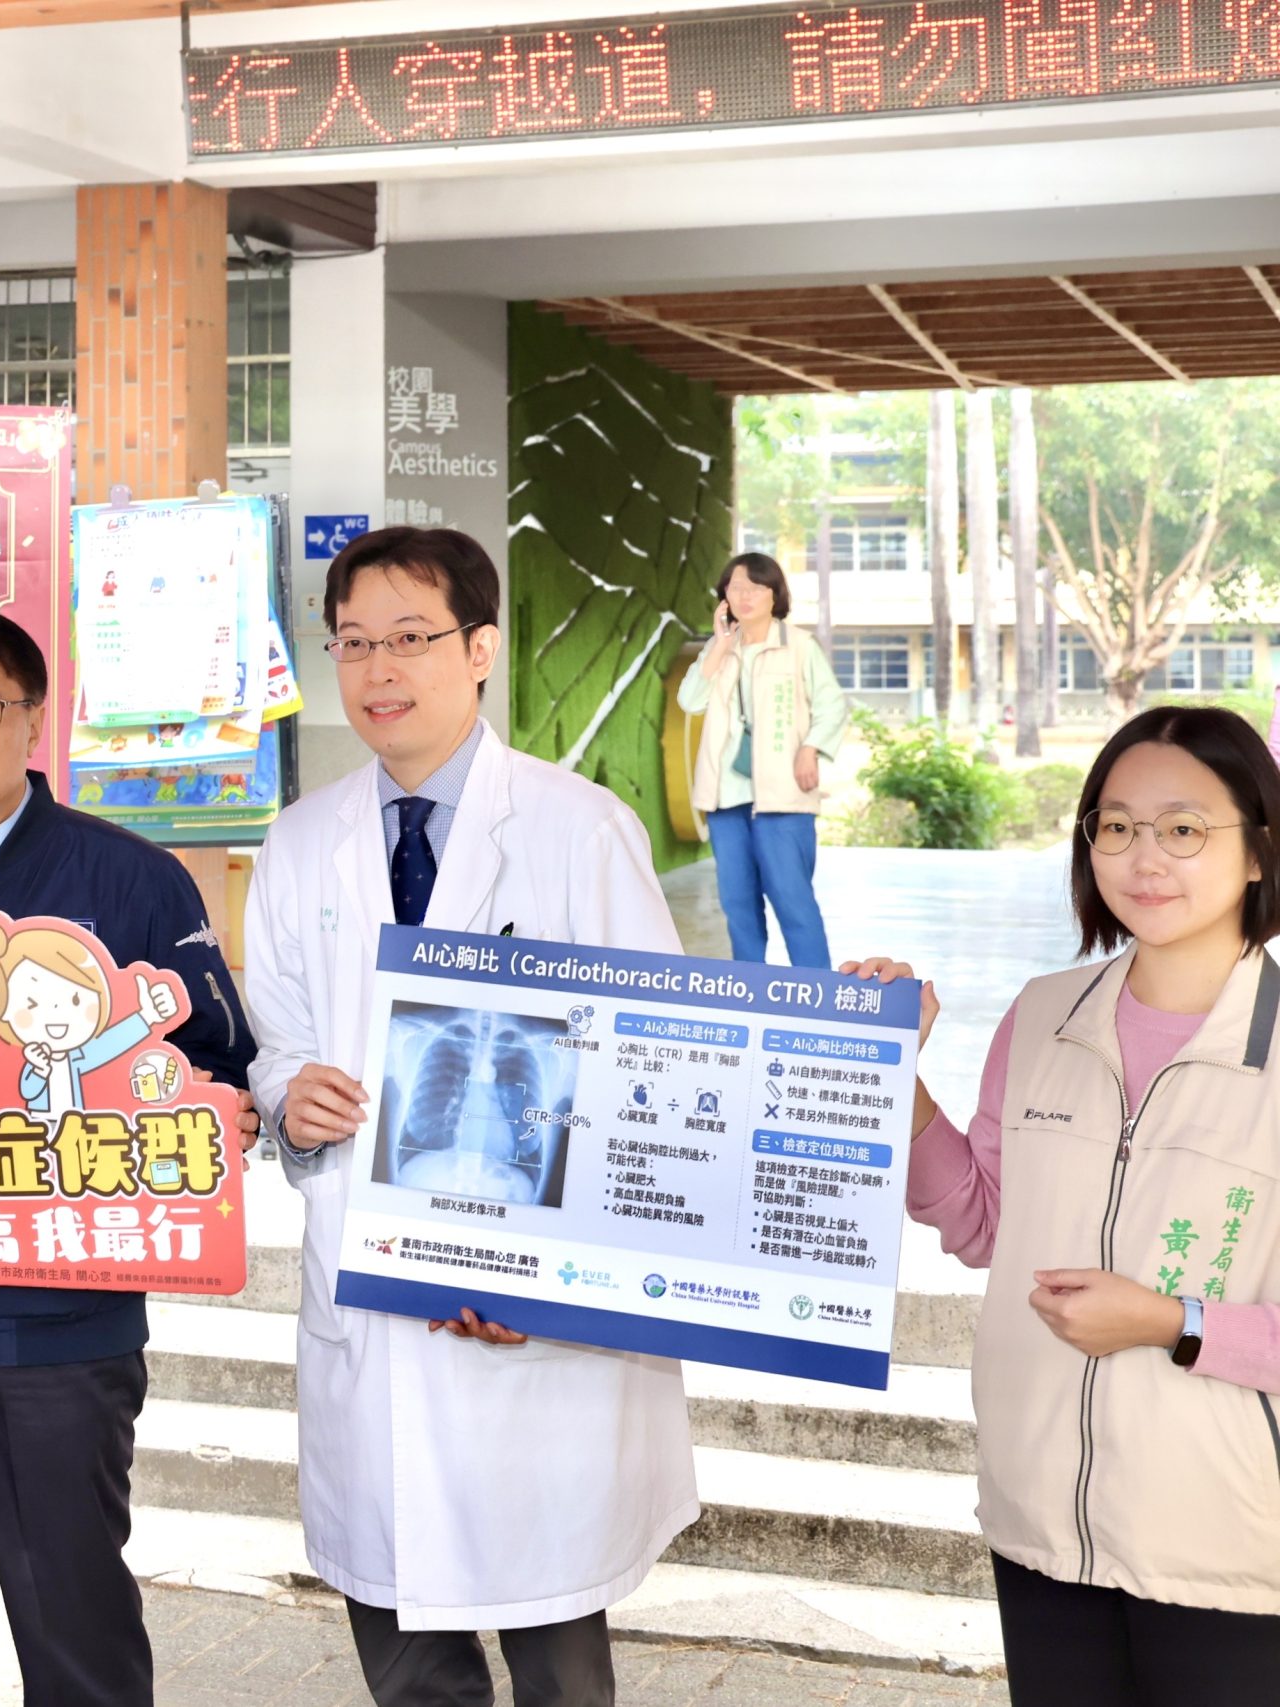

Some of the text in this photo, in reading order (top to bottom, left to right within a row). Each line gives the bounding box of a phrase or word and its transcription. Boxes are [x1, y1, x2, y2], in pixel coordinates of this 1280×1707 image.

[189, 0, 1280, 151] 行人穿越道，請勿闖紅
[387, 366, 433, 393] 校園
[387, 393, 459, 434] 美學
[387, 438, 442, 457] Campus
[387, 453, 498, 477] Aesthetics
[344, 518, 366, 529] WC
[554, 1037, 600, 1052] AI自動判讀
[767, 1035, 879, 1060] 二、AI心胸比的特色
[788, 1064, 881, 1087] AI自動判讀X光影像
[786, 1086, 894, 1110] 快速、標準化量測比例
[617, 1108, 658, 1125] 心臟寬度
[684, 1116, 727, 1134] 胸腔寬度
[784, 1107, 881, 1131] 不是另外照新的檢查
[758, 1134, 870, 1161] 三、檢查定位與功能
[606, 1153, 654, 1170] 可能代表：
[615, 1171, 657, 1188] 心臟肥大
[430, 1196, 507, 1219] 胸部X光影像示意
[613, 1187, 686, 1208] 高血壓長期負擔
[753, 1190, 814, 1209] 可協助判斷：
[611, 1202, 704, 1227] 心臟功能異常的風險
[762, 1209, 859, 1233] 心臟是否視覺上偏大
[31, 1204, 205, 1264] 我最行
[761, 1225, 868, 1251] 是否有潛在心血管負擔
[401, 1237, 540, 1268] 臺南市政府衛生局關心您 廣告
[759, 1241, 877, 1270] 是否需進一步追蹤或轉介
[76, 1270, 111, 1283] 關心您
[582, 1269, 611, 1281] EVER
[671, 1279, 761, 1303] 中國醫藥大學附設醫院
[688, 1294, 709, 1303] Medical
[818, 1301, 872, 1320] 中國醫藥大學
